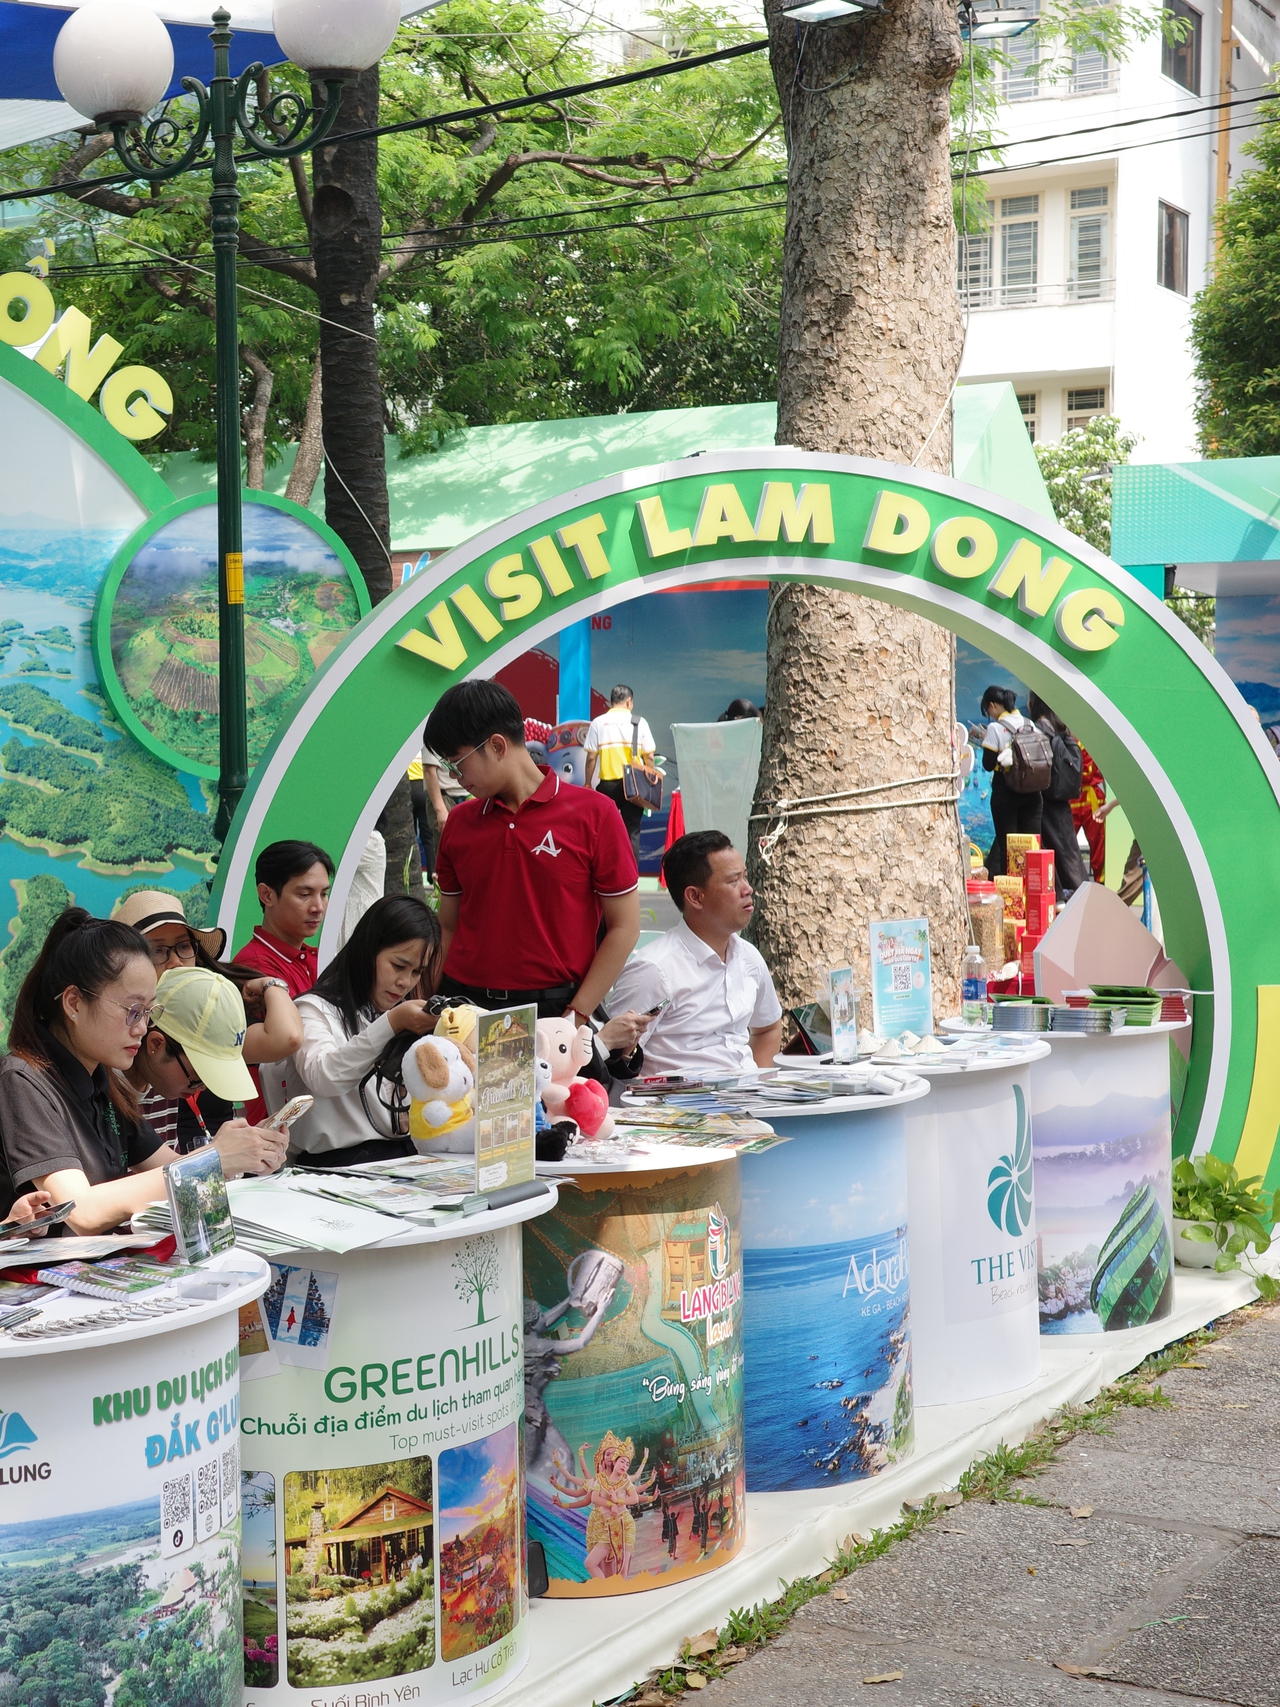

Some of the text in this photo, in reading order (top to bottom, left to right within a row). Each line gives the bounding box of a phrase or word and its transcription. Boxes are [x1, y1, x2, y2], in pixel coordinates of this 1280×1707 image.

[396, 482, 1125, 671] VISIT LAM DONG
[971, 1251, 1015, 1285] THE
[861, 1306, 871, 1317] KE
[991, 1285, 1014, 1305] Beach
[324, 1323, 519, 1403] GREENHILLS
[690, 1372, 712, 1396] sáng
[93, 1385, 150, 1426] KHU
[156, 1375, 187, 1411] DU
[191, 1358, 222, 1403] LỊCH
[240, 1412, 306, 1435] Chuỗi
[314, 1415, 348, 1438] địa
[355, 1405, 401, 1430] điểm
[407, 1403, 428, 1422] du
[432, 1393, 458, 1420] lịch
[462, 1382, 492, 1408] tham
[493, 1375, 514, 1402] quan
[145, 1412, 201, 1468] ĐẮK
[389, 1434, 419, 1453] Top
[422, 1416, 485, 1445] must-visit
[487, 1403, 509, 1428] spots
[355, 1692, 390, 1707] Bình
[394, 1685, 421, 1702] Yên
[452, 1667, 473, 1687] Lạc
